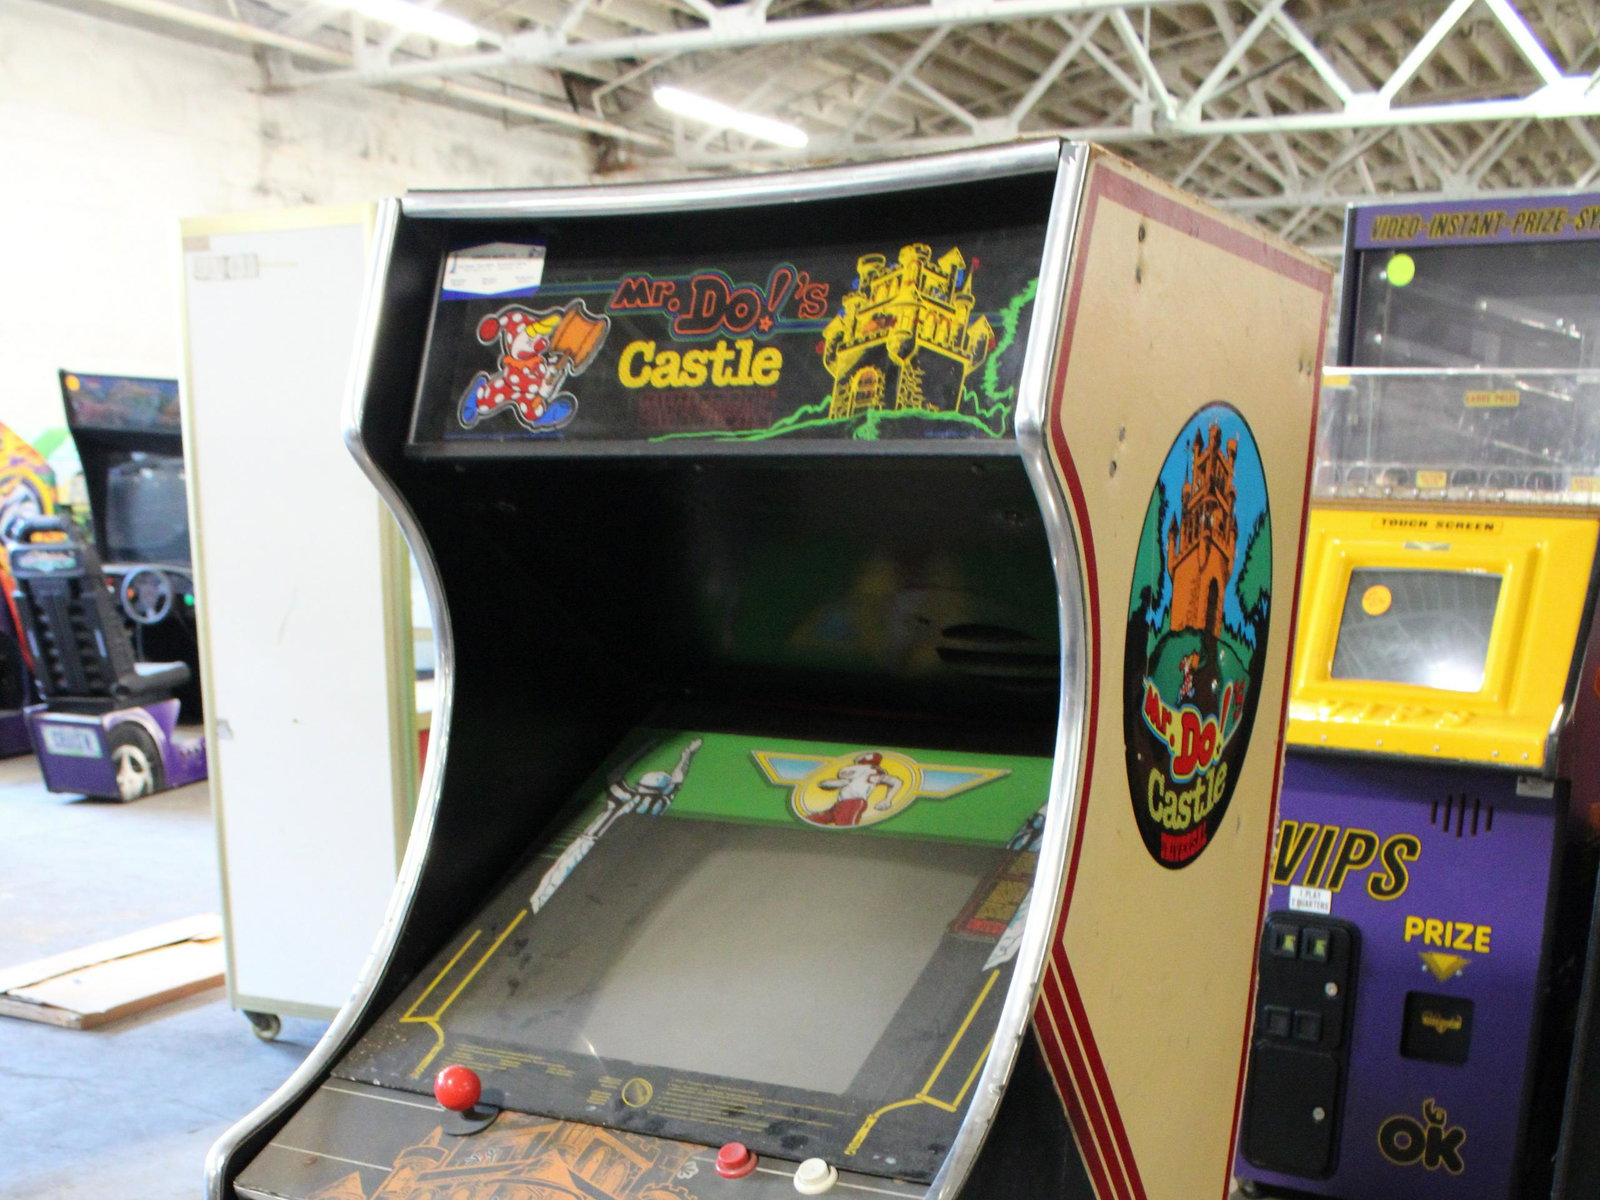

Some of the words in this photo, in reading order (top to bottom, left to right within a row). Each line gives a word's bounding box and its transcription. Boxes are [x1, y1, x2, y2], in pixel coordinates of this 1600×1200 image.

[618, 339, 783, 388] Castle
[1381, 518, 1428, 529] TOUCH
[1435, 519, 1495, 531] SCREEN
[1147, 761, 1228, 830] Castle
[1272, 820, 1421, 901] VIPS
[1404, 916, 1492, 953] PRIZE
